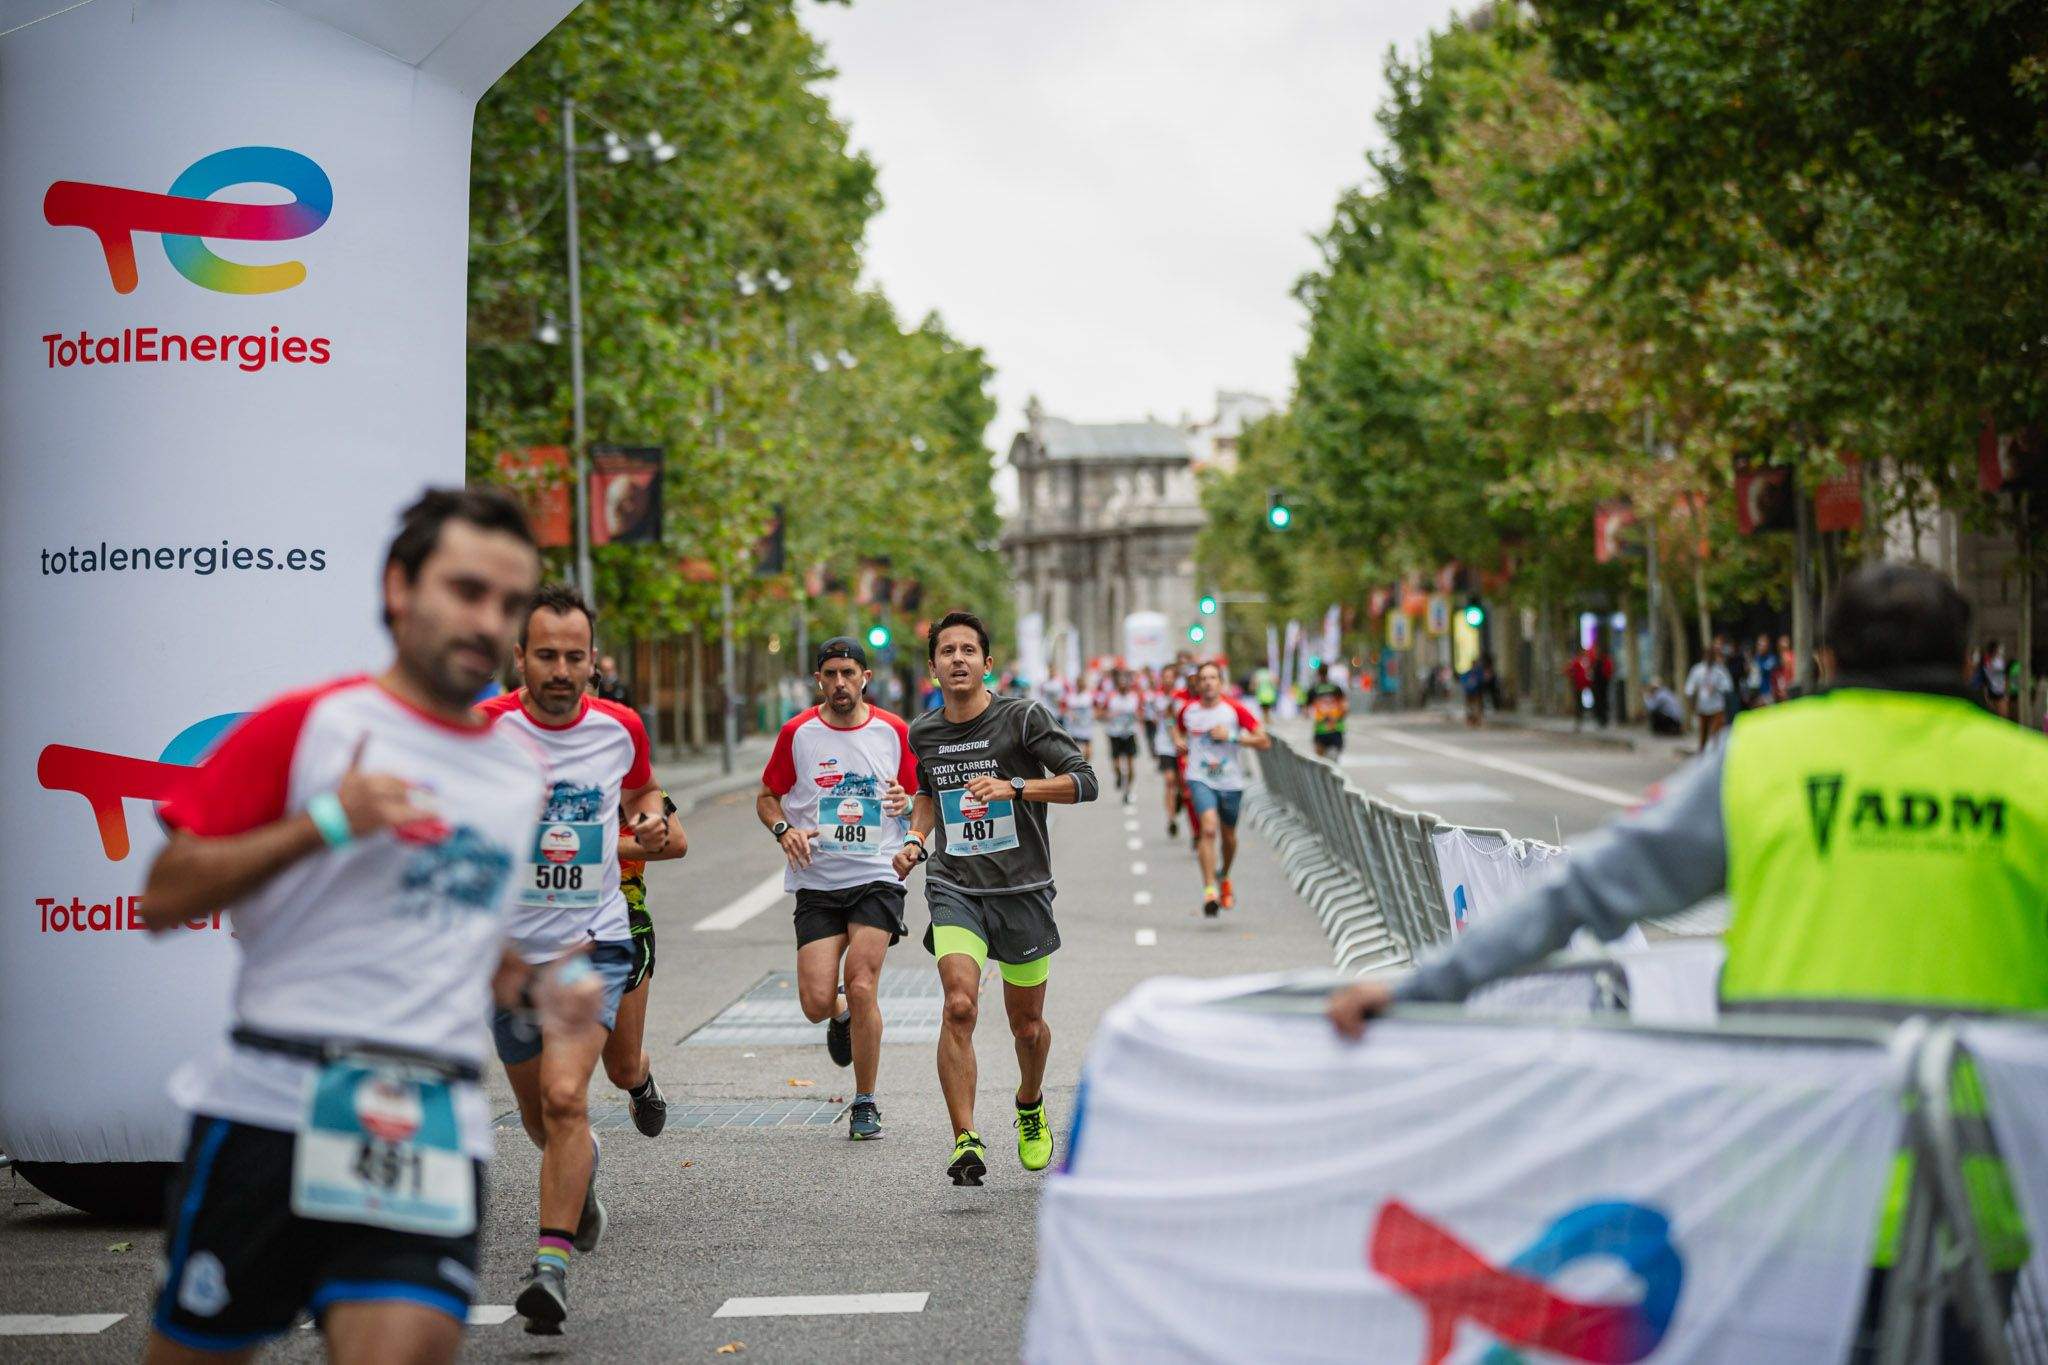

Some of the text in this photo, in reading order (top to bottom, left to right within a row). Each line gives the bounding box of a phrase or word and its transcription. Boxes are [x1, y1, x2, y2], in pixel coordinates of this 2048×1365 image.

[42, 325, 331, 372] TotalEnergies
[41, 540, 326, 576] totalenergies.es
[938, 740, 990, 754] BRIDGESTONE
[932, 759, 998, 776] XXXIX CARRERA
[937, 776, 948, 786] DE
[949, 775, 961, 785] LA
[1852, 790, 2007, 836] ADM
[834, 825, 866, 842] 489
[962, 819, 994, 842] 487
[536, 864, 582, 890] 508
